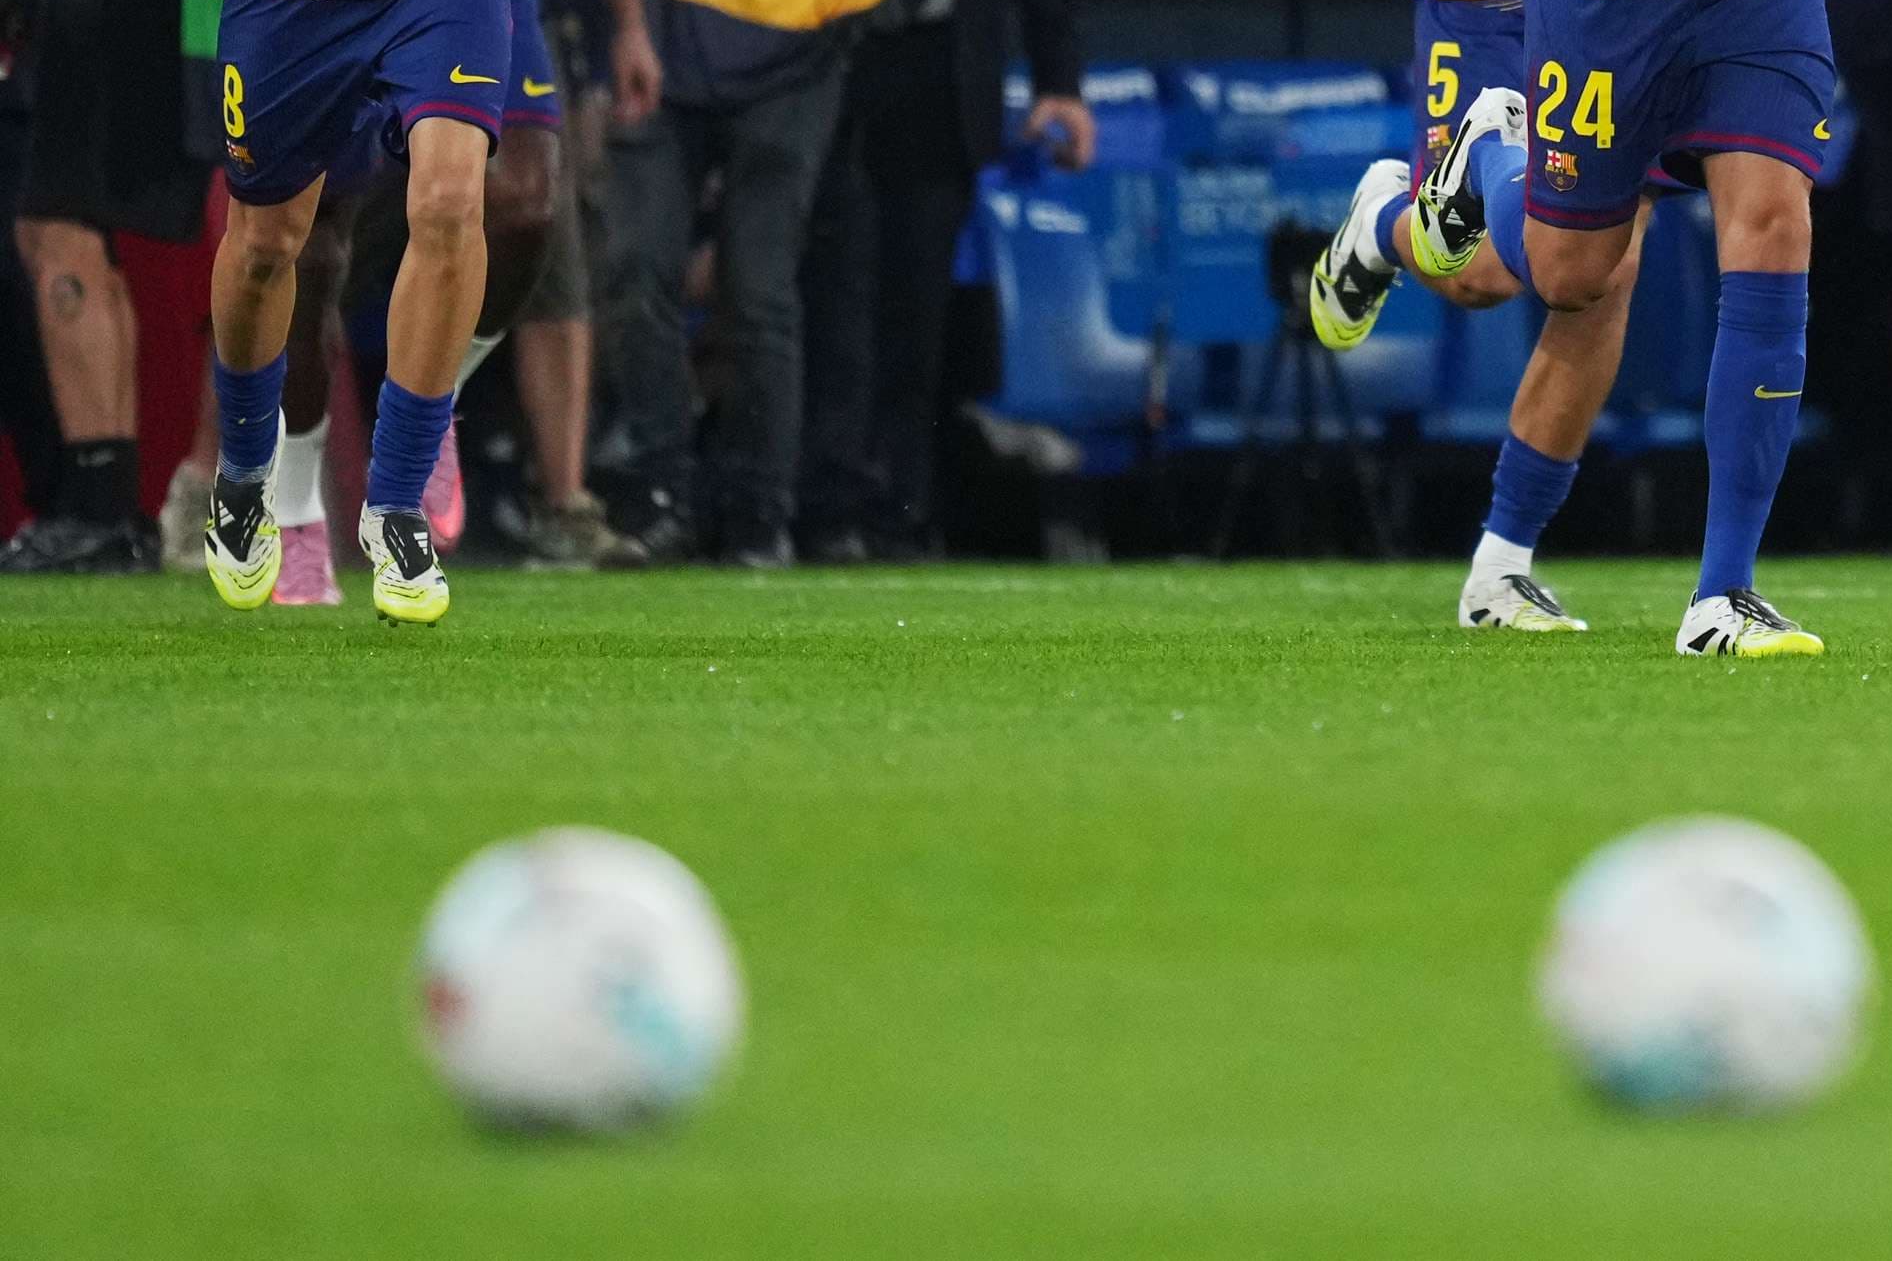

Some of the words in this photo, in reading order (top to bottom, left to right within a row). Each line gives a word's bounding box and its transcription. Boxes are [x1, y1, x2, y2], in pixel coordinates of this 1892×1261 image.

[223, 64, 246, 139] 8
[1427, 41, 1461, 118] 5
[1536, 59, 1615, 149] 24
